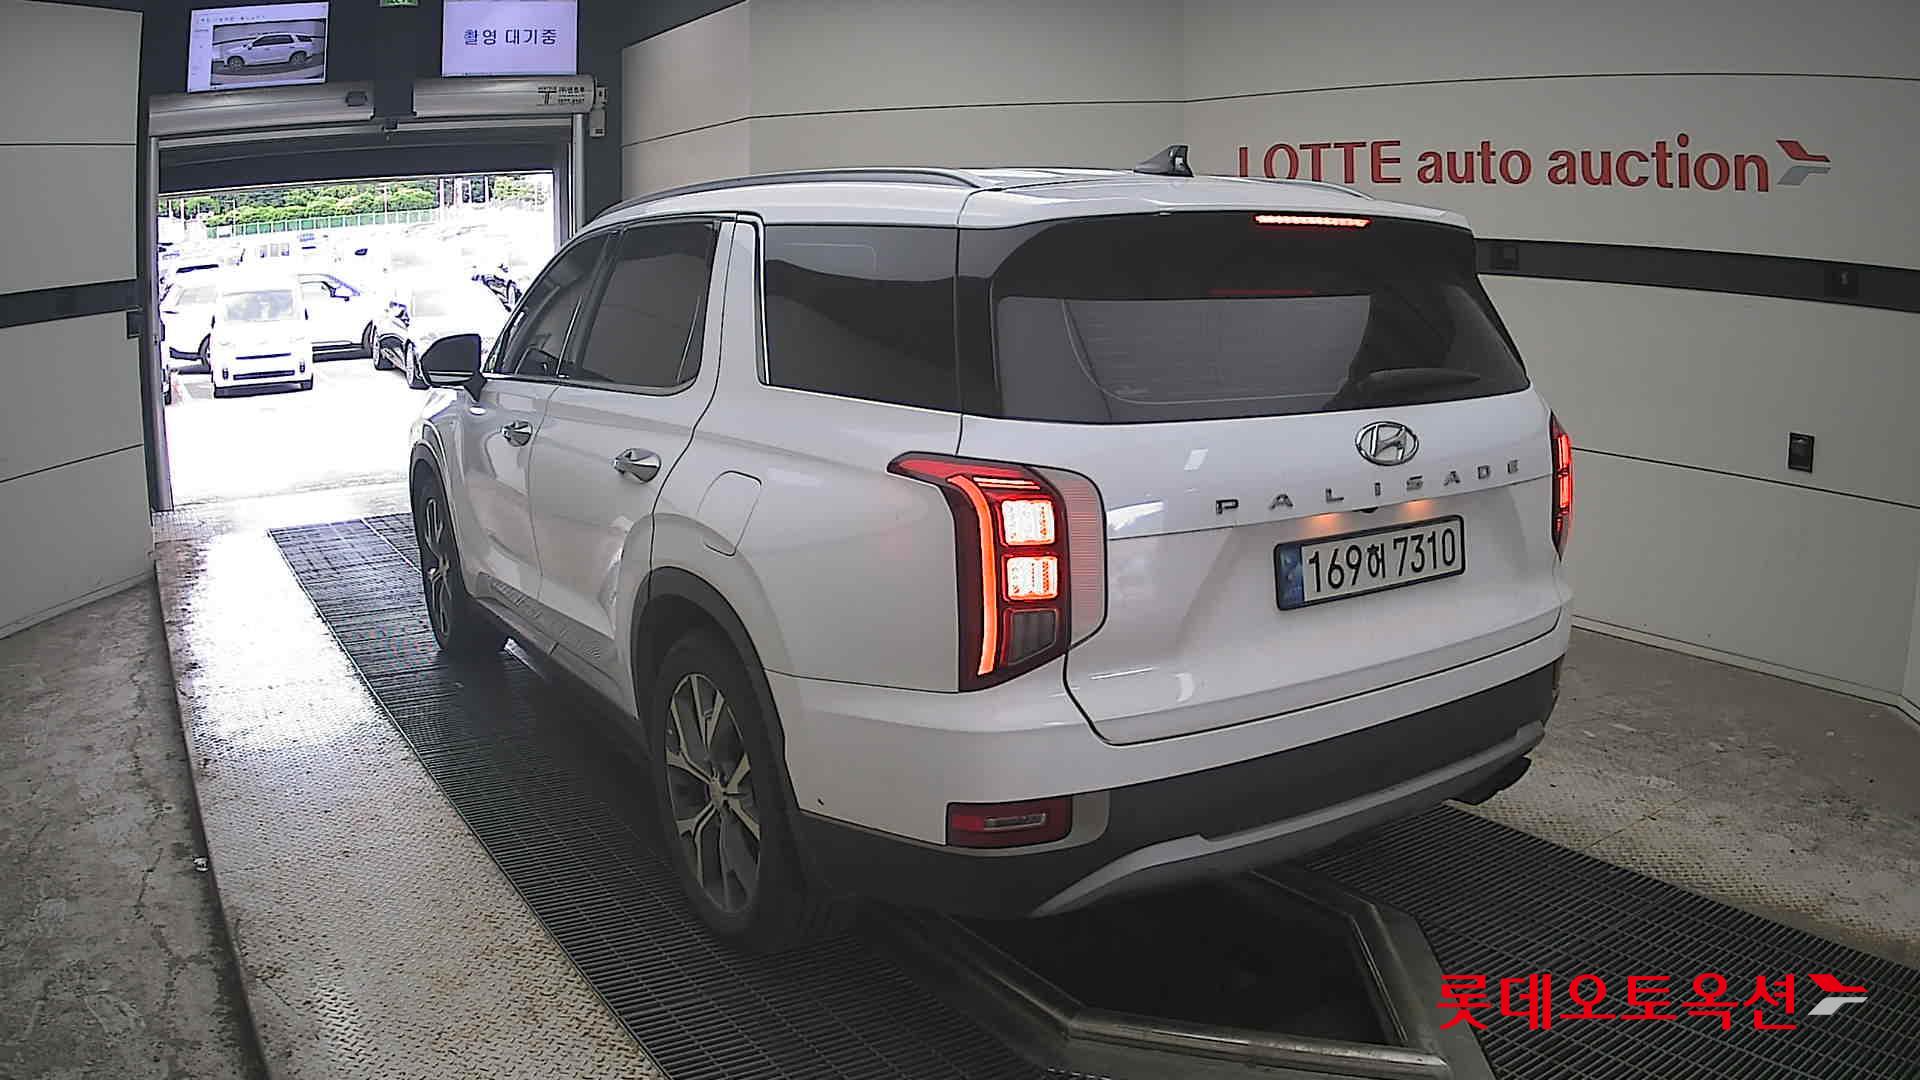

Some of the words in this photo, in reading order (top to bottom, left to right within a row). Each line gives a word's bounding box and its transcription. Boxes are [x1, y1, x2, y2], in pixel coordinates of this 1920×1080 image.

[505, 29, 557, 46] 대기중
[1417, 140, 1531, 186] auto
[1547, 133, 1769, 193] auction
[1215, 459, 1520, 515] PALISADE
[1308, 544, 1386, 593] 169허
[1393, 527, 1456, 577] 7310
